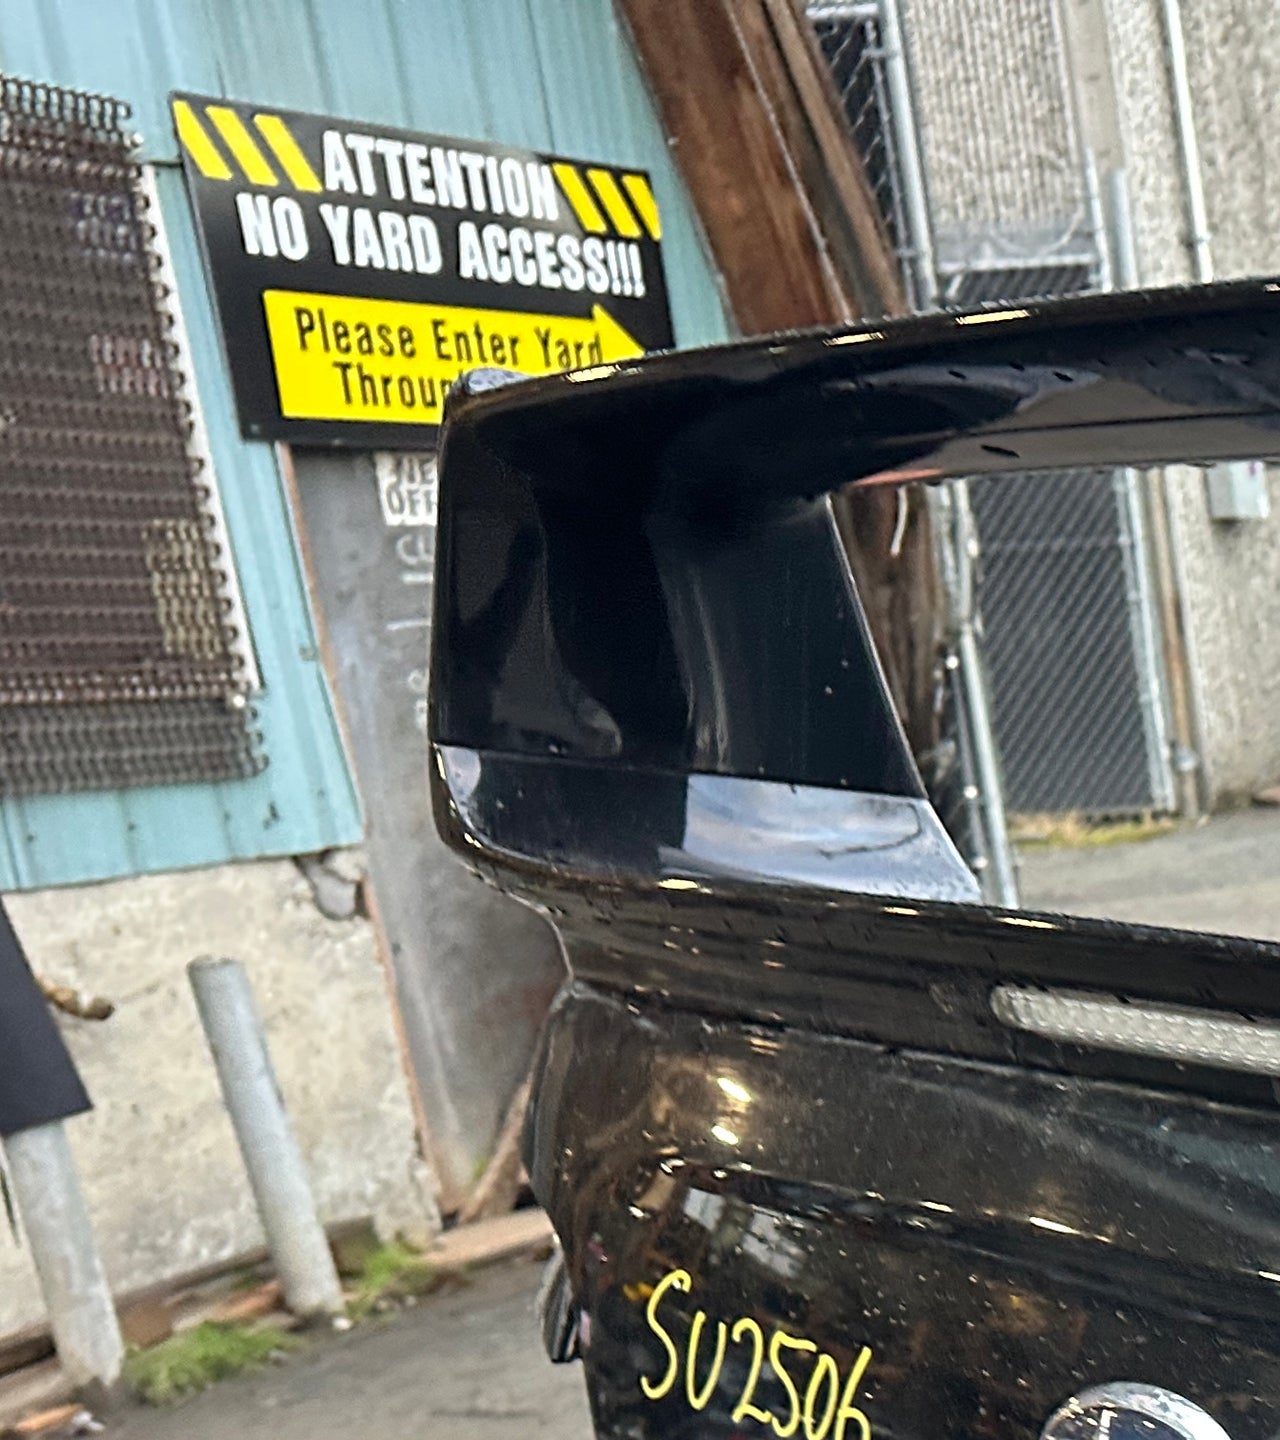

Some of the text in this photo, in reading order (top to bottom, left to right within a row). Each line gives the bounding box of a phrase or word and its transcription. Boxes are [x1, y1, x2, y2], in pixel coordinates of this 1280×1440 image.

[321, 129, 561, 222] ATTENTION
[235, 191, 647, 299] NO YARD ACCESS!!!
[294, 306, 604, 370] Please Enter Yard
[332, 361, 464, 409] Throu
